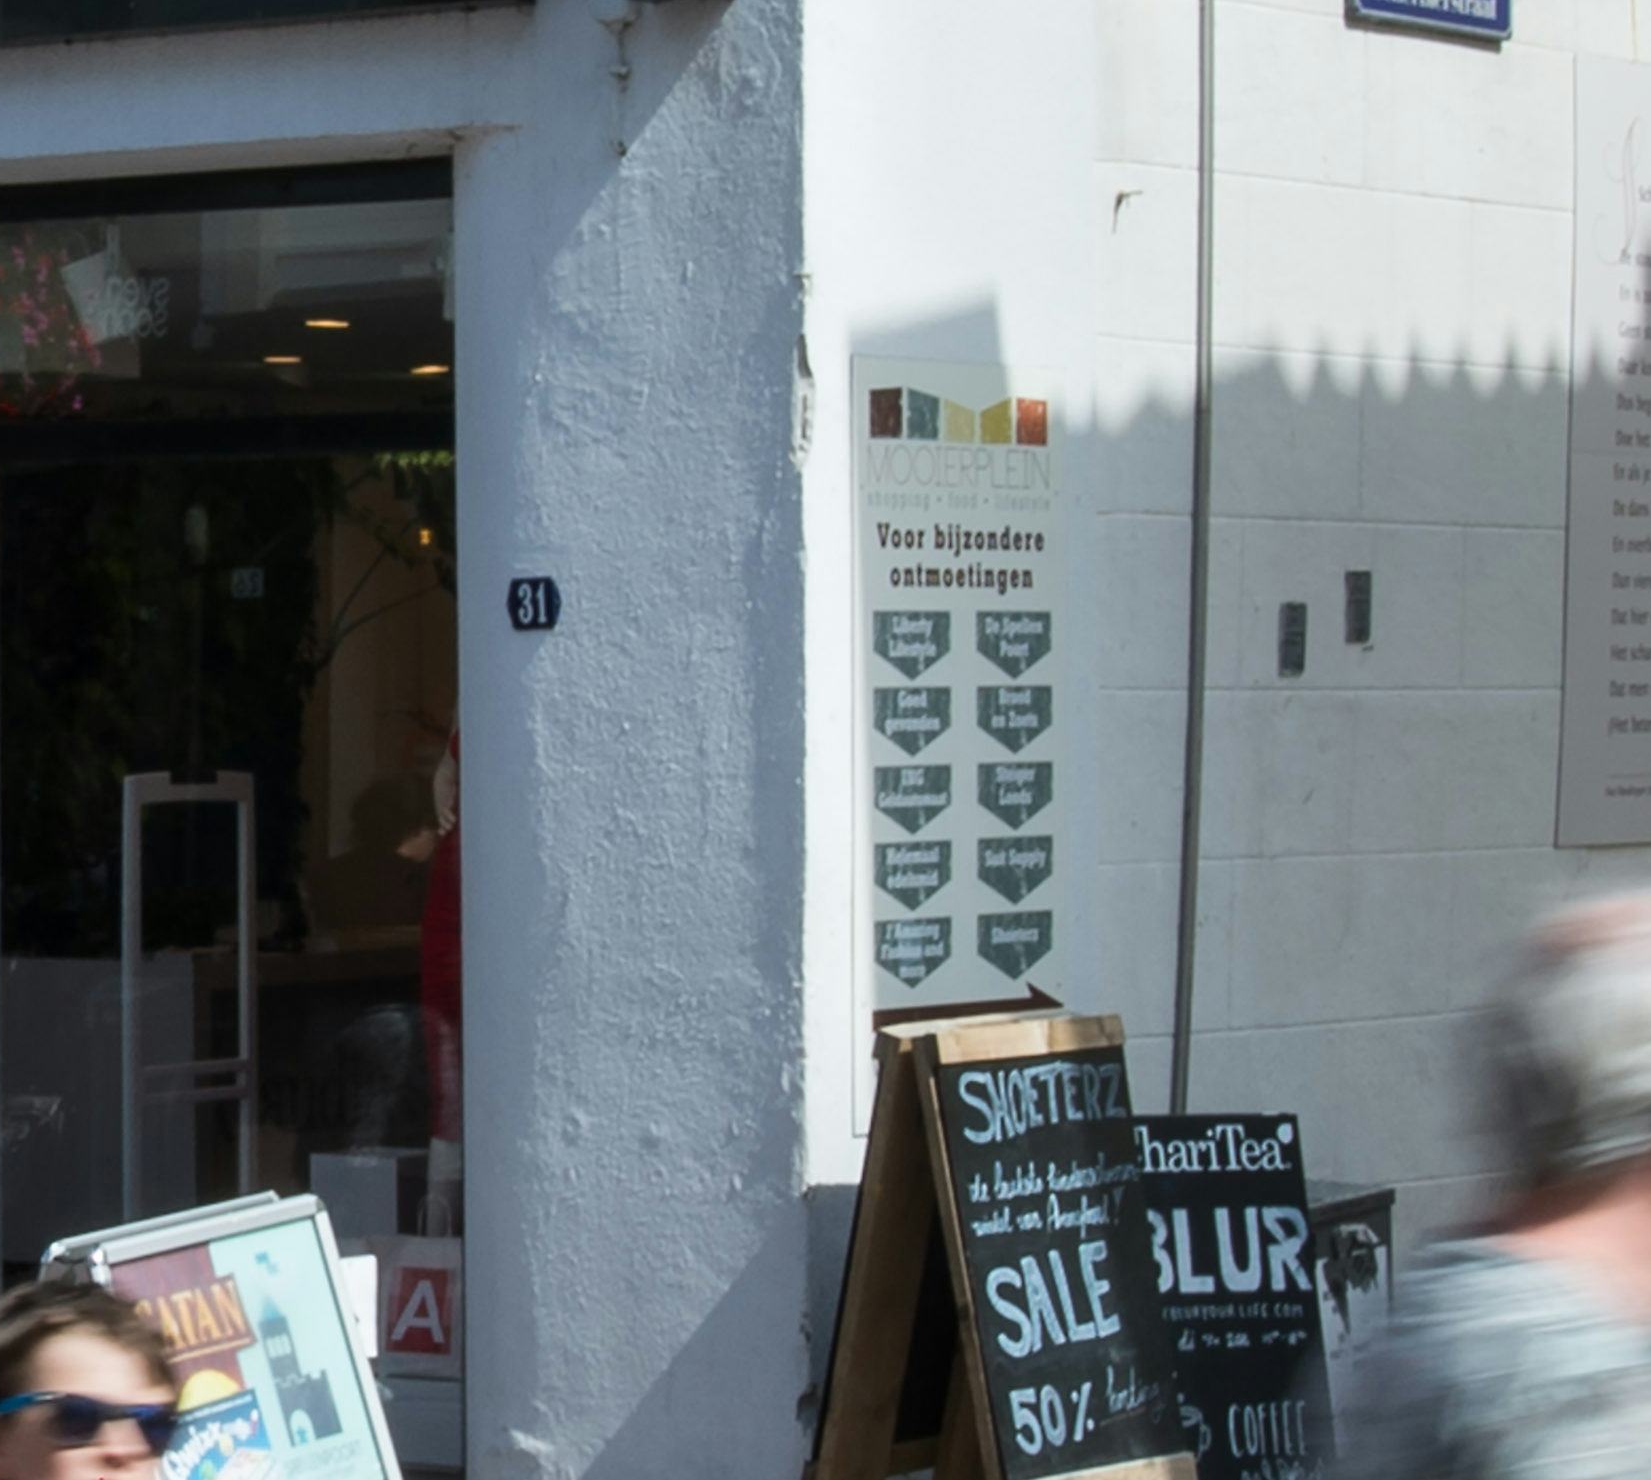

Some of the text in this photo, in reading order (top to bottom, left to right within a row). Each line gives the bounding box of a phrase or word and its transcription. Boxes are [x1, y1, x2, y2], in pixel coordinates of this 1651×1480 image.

[866, 443, 1050, 491] MOOIERPLEIN
[876, 521, 1046, 559] Voor bijzondere
[517, 581, 548, 626] 31
[889, 561, 1034, 597] ontmoetingen
[958, 1060, 1127, 1145] SHOETERZ
[1134, 1122, 1286, 1172] hariTea
[134, 1279, 247, 1352] ATAN
[985, 1239, 1122, 1359] SALE
[1008, 1381, 1095, 1456] 50%
